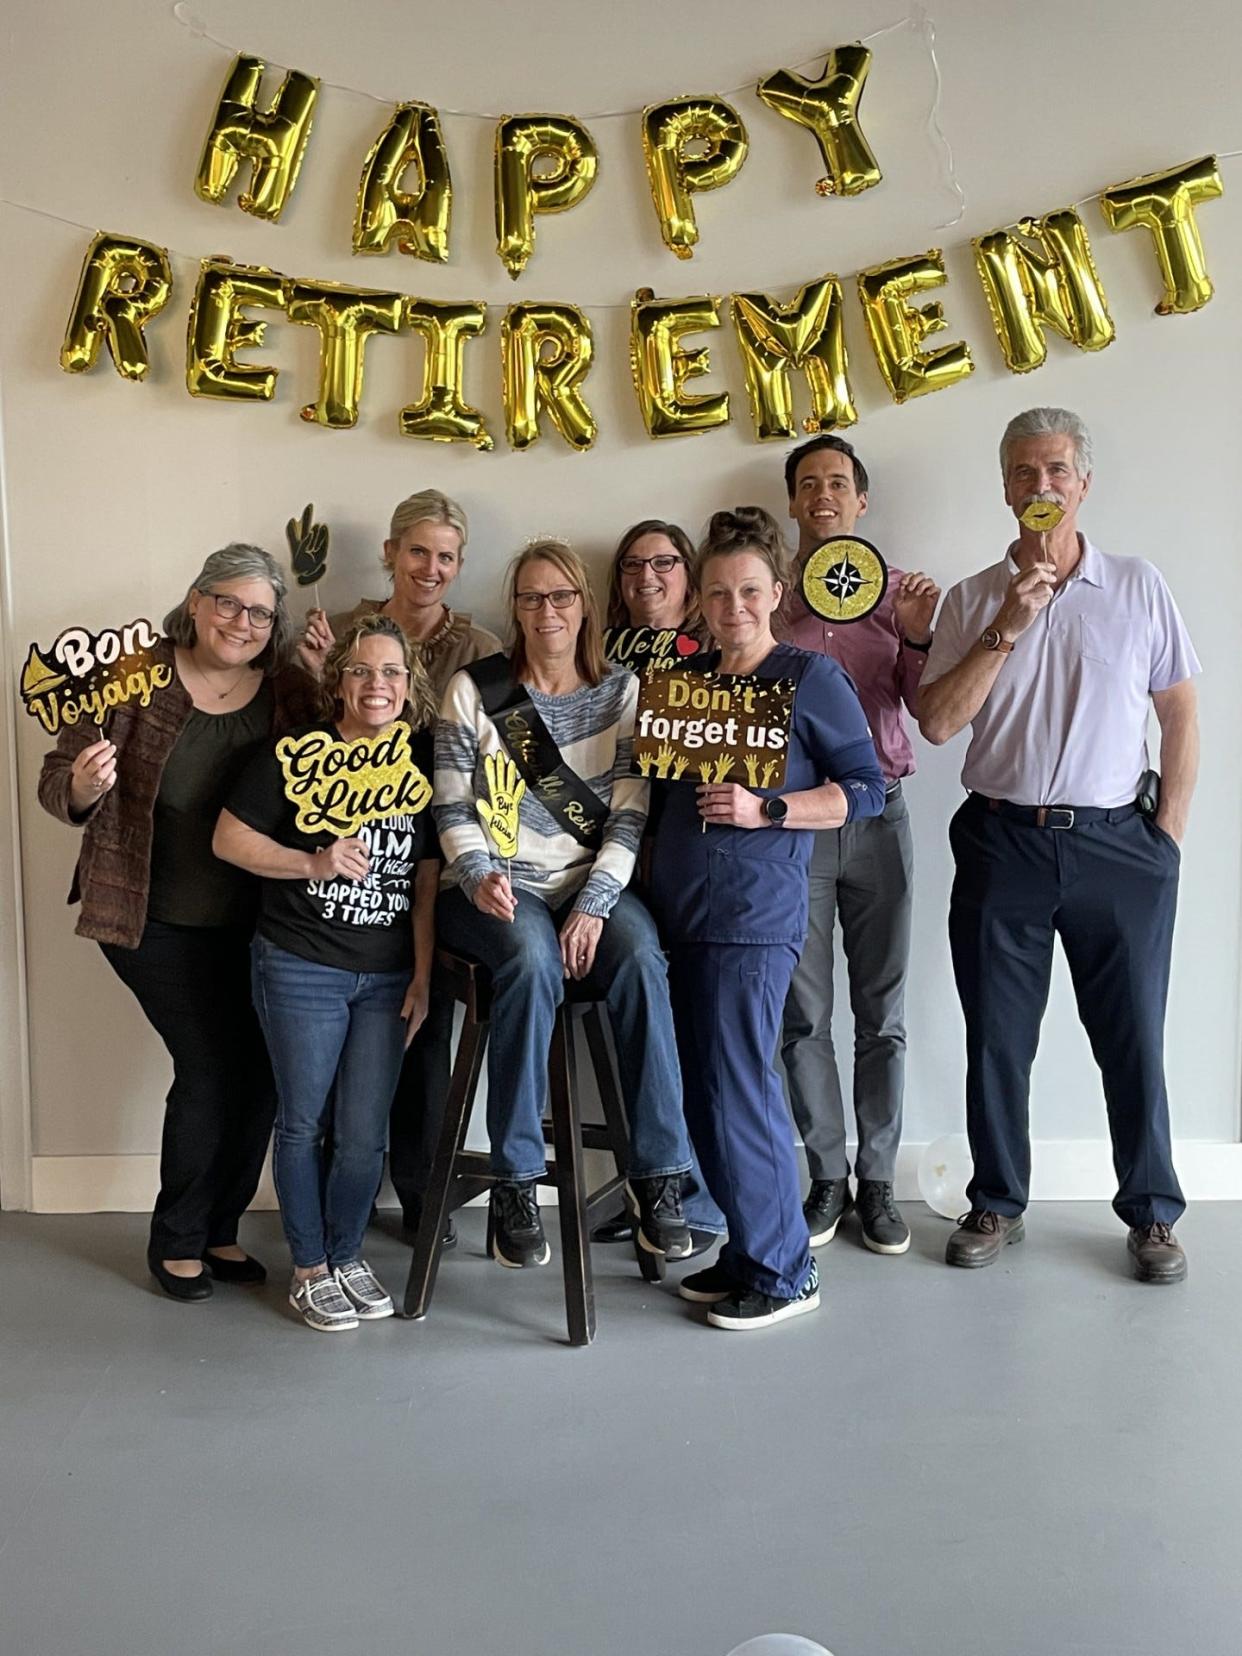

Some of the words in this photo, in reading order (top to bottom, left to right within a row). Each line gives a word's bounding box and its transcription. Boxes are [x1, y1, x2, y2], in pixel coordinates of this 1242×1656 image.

[193, 41, 883, 281] HAPPY
[59, 153, 1224, 453] RETIREMENT
[55, 621, 158, 677] Bon
[601, 627, 677, 660] We'll
[30, 663, 173, 733] Voyage
[667, 678, 756, 714] Don't
[639, 709, 738, 748] forget
[746, 725, 785, 749] us
[283, 727, 405, 795] Good
[303, 770, 425, 830] Luck
[358, 826, 412, 860] ALM
[381, 814, 416, 834] LOOK
[306, 879, 383, 909] SLAPPED
[386, 892, 410, 912] YOU
[321, 900, 336, 919] 3
[341, 904, 396, 926] TIMES
